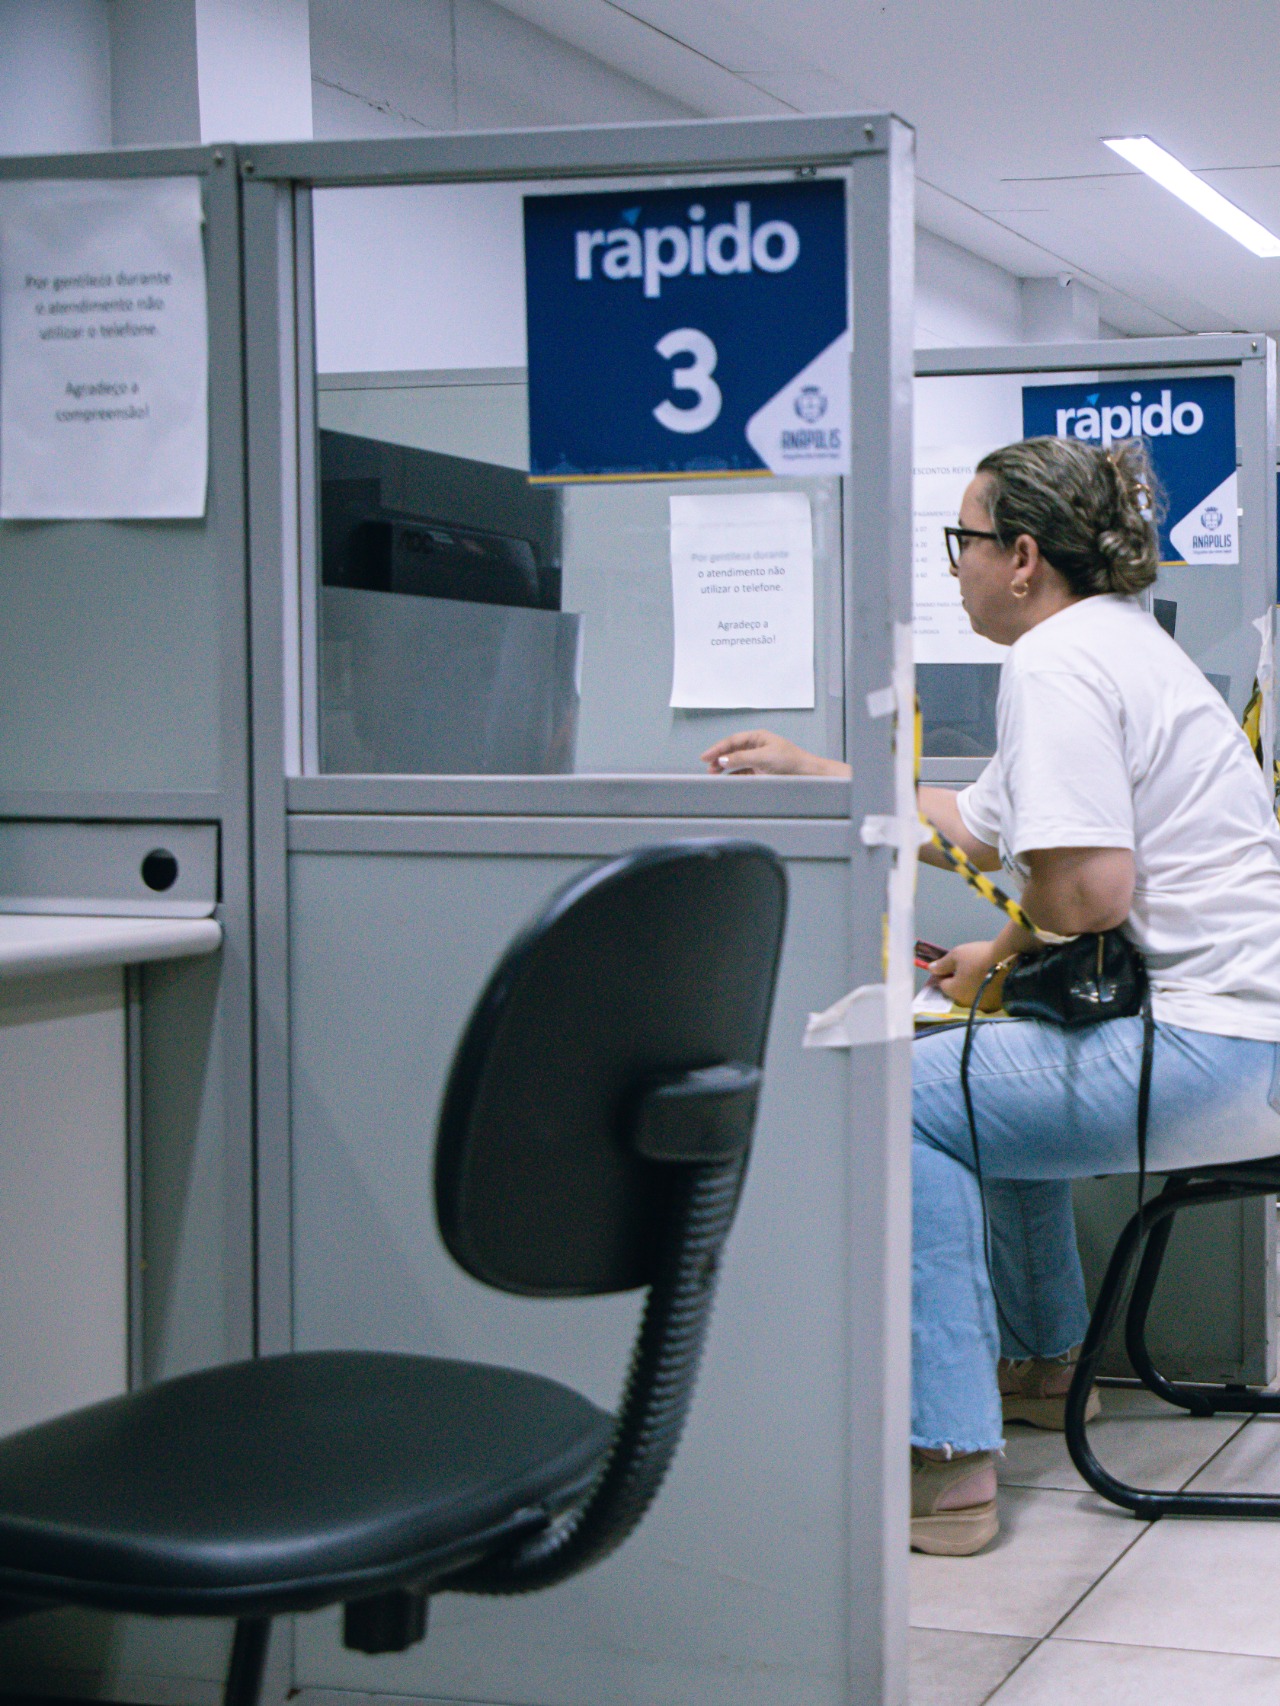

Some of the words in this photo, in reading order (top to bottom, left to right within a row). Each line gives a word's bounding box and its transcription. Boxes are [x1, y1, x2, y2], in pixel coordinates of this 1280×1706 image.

[575, 201, 800, 298] rápido
[653, 327, 722, 433] 3
[1056, 390, 1204, 446] rápido
[698, 570, 705, 578] o
[707, 568, 765, 578] atendimento
[768, 565, 786, 576] não
[700, 584, 731, 594] utilizar
[734, 585, 740, 593] o
[742, 583, 784, 593] telefone.
[718, 620, 761, 632] Agradeço
[763, 621, 769, 629] a
[711, 635, 776, 646] compreensão!
